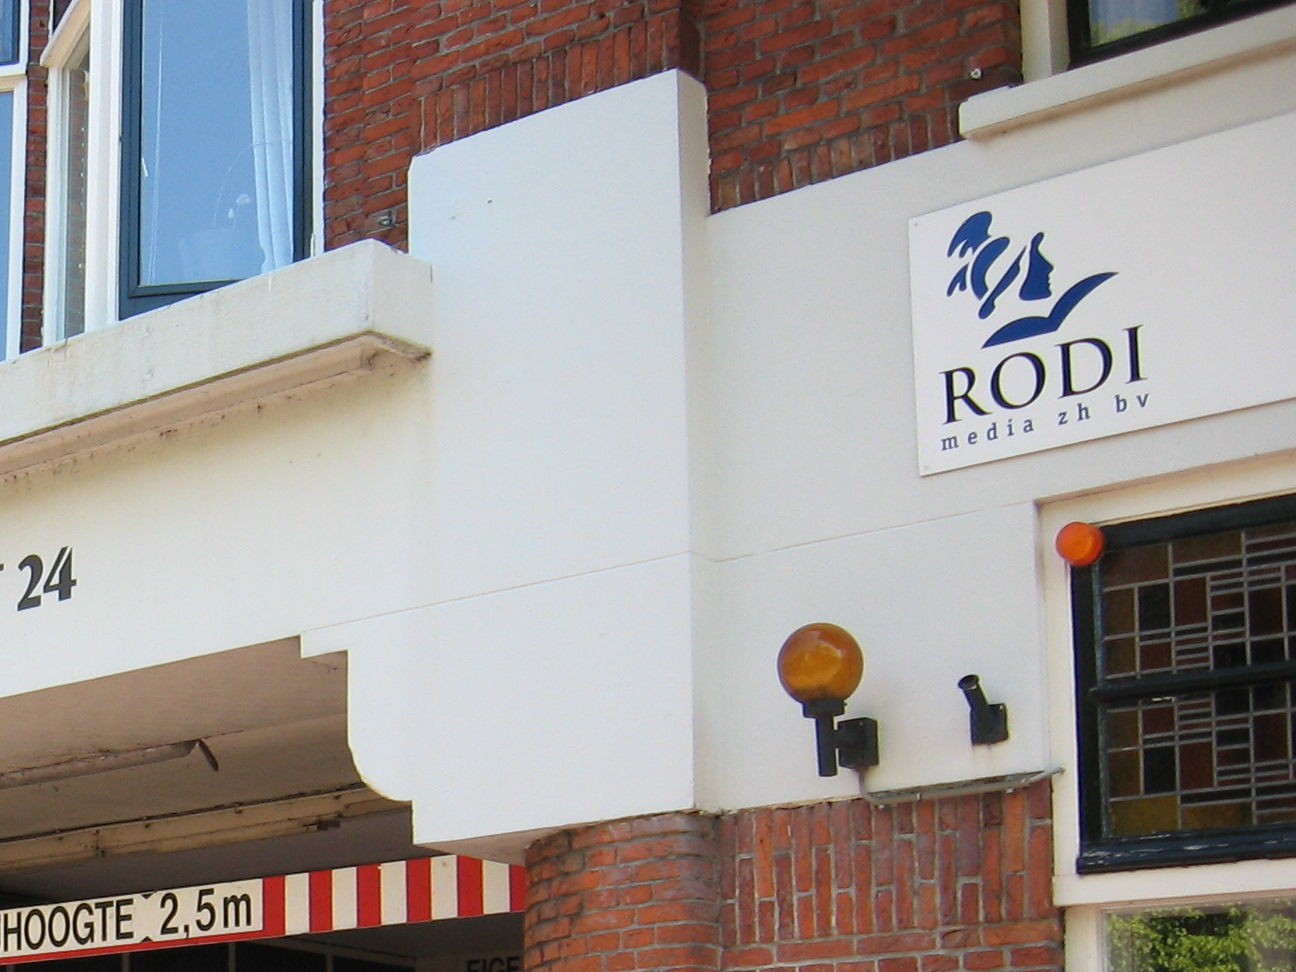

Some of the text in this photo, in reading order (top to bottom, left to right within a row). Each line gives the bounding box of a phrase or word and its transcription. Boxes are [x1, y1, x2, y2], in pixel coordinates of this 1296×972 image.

[939, 324, 1148, 425] RODI
[941, 393, 1149, 451] media zh bv
[17, 546, 77, 611] 24
